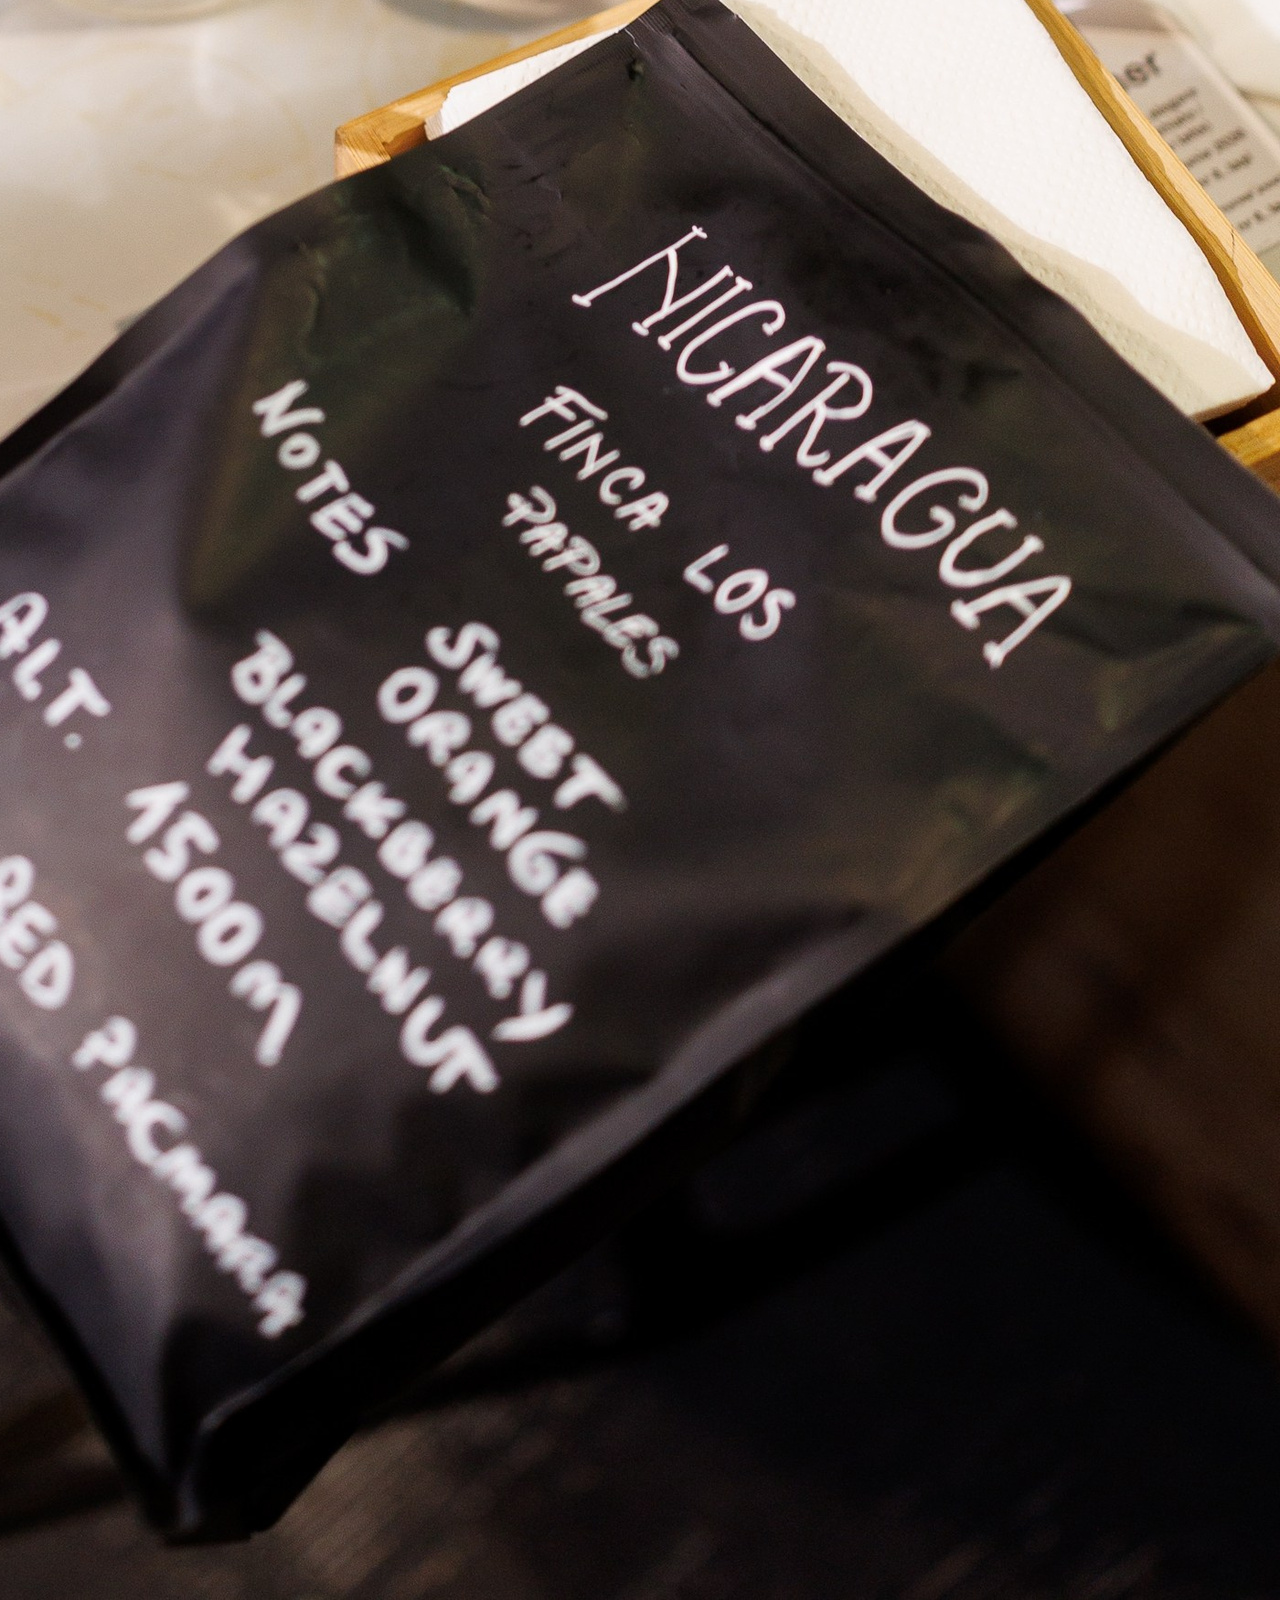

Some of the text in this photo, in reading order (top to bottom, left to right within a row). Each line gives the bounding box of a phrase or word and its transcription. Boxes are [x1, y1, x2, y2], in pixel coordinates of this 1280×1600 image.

[1116, 52, 1160, 90] er
[253, 380, 620, 807] NOTES SWEET
[504, 484, 677, 677] PAPALES
[519, 385, 796, 641] FINCA LOS
[570, 224, 1072, 667] NICARAGUA
[207, 725, 495, 1090] HAZELNUT
[232, 632, 569, 1041] BLACKBERRY
[378, 666, 597, 927] ORANGE
[70, 1013, 306, 1338] PACMARA
